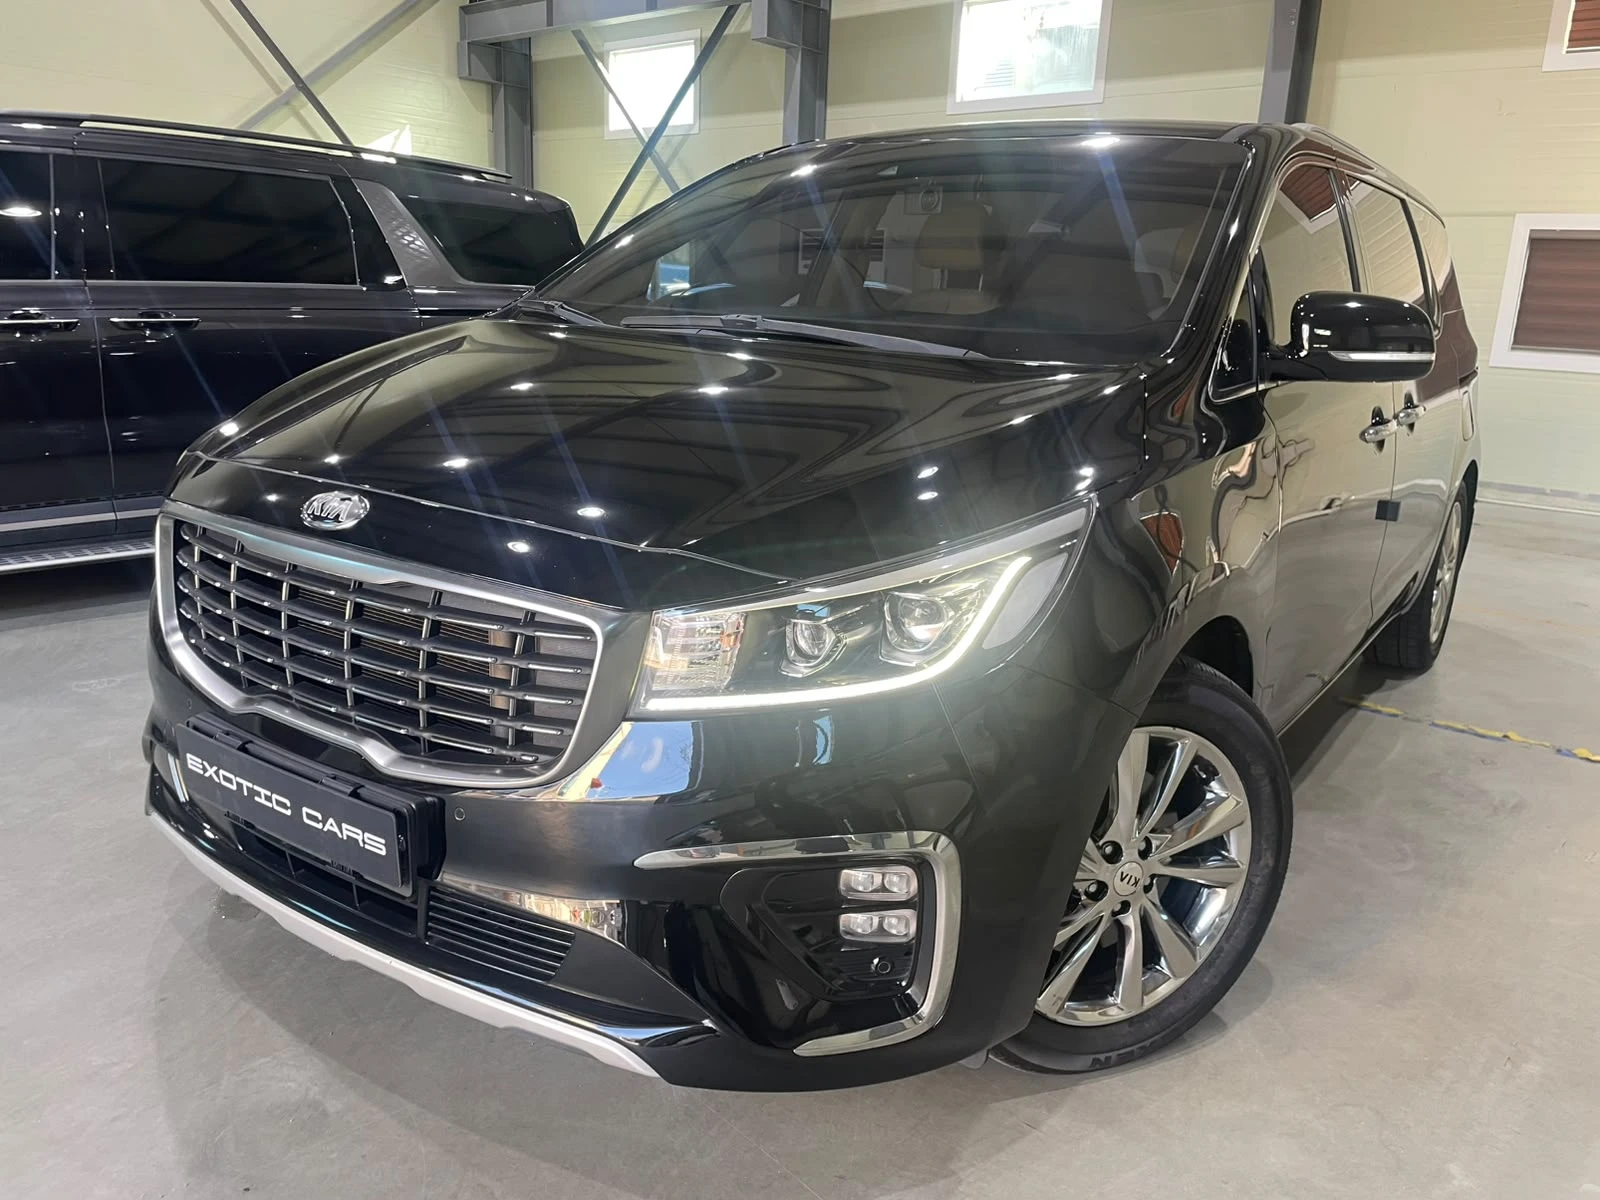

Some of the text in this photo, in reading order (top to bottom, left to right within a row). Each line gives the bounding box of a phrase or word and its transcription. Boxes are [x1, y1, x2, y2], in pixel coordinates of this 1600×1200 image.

[303, 494, 355, 524] KIA
[186, 753, 387, 856] EXOTIC CARS
[1119, 871, 1141, 888] KIA
